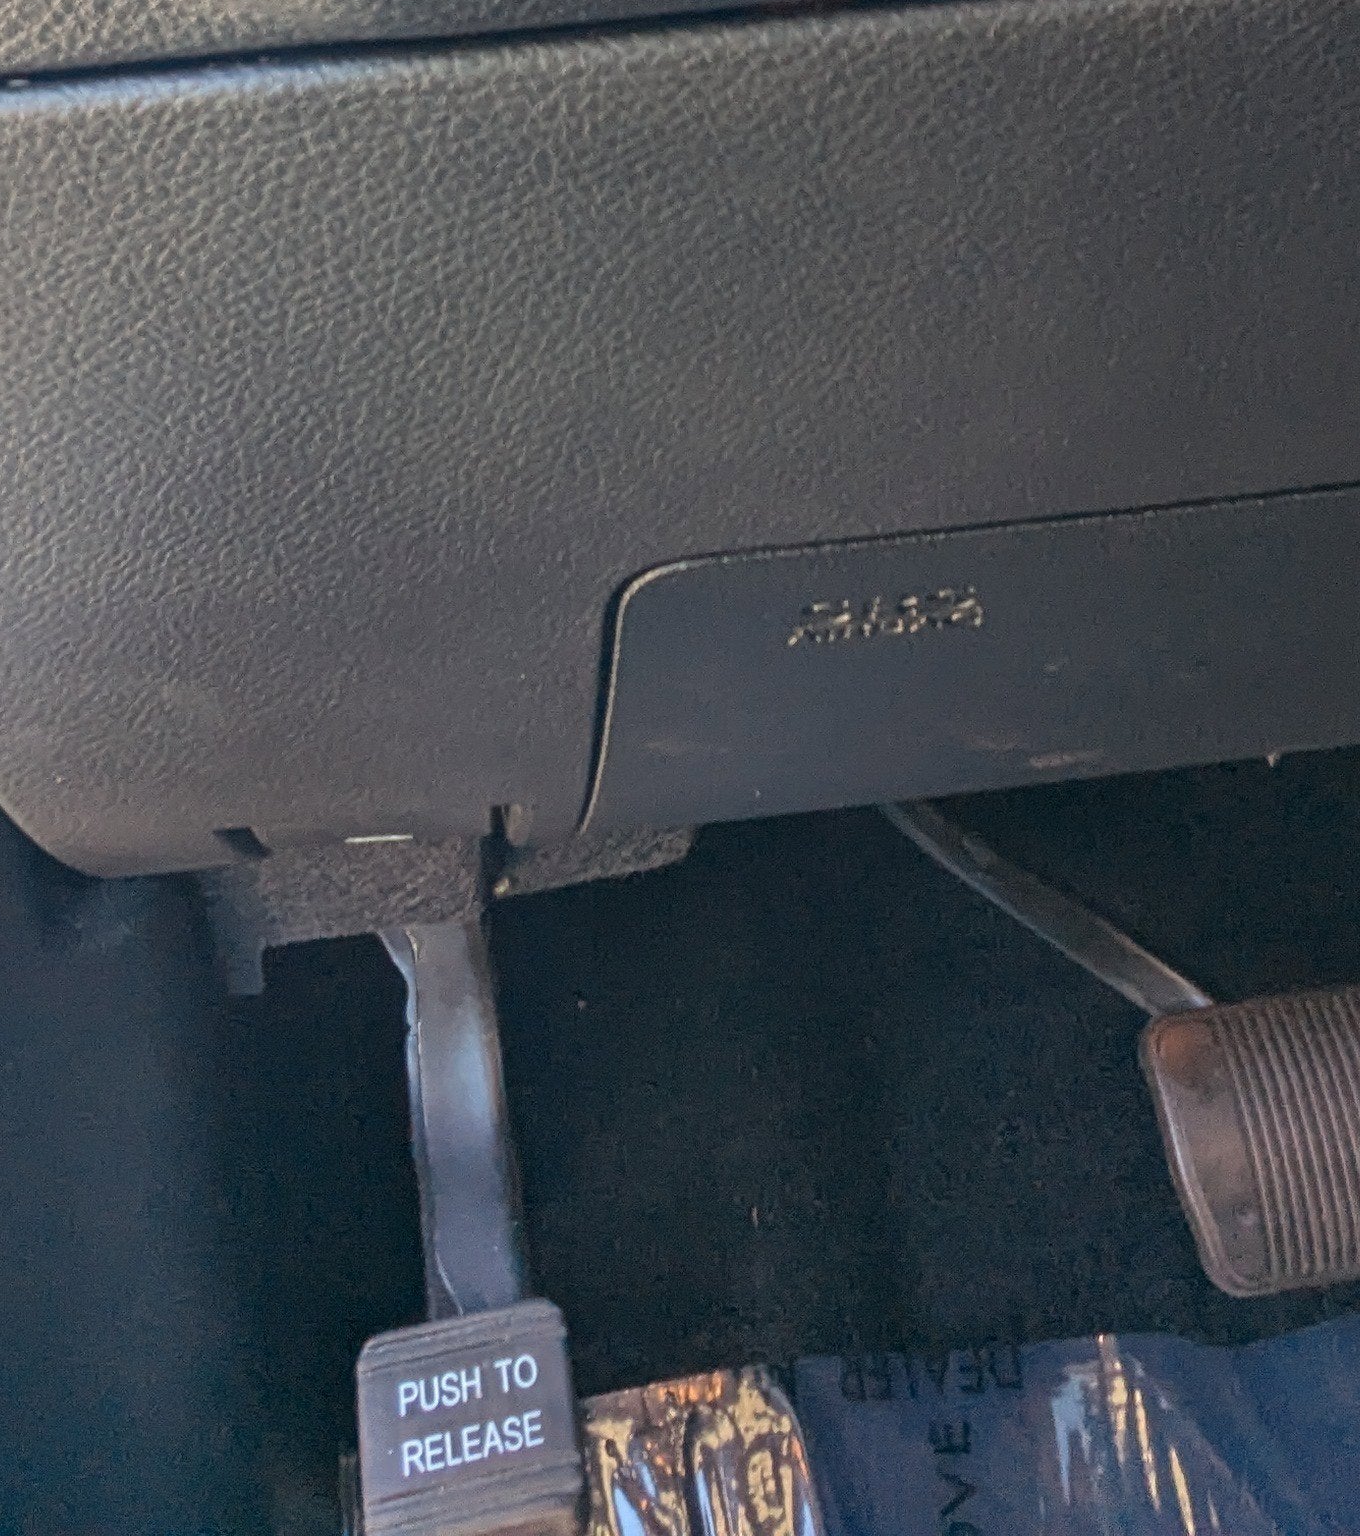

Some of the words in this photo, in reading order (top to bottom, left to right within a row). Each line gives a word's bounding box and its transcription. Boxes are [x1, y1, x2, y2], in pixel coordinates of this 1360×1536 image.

[397, 1366, 483, 1417] PUSH
[494, 1354, 538, 1393] TO
[401, 1410, 545, 1477] RELEASE
